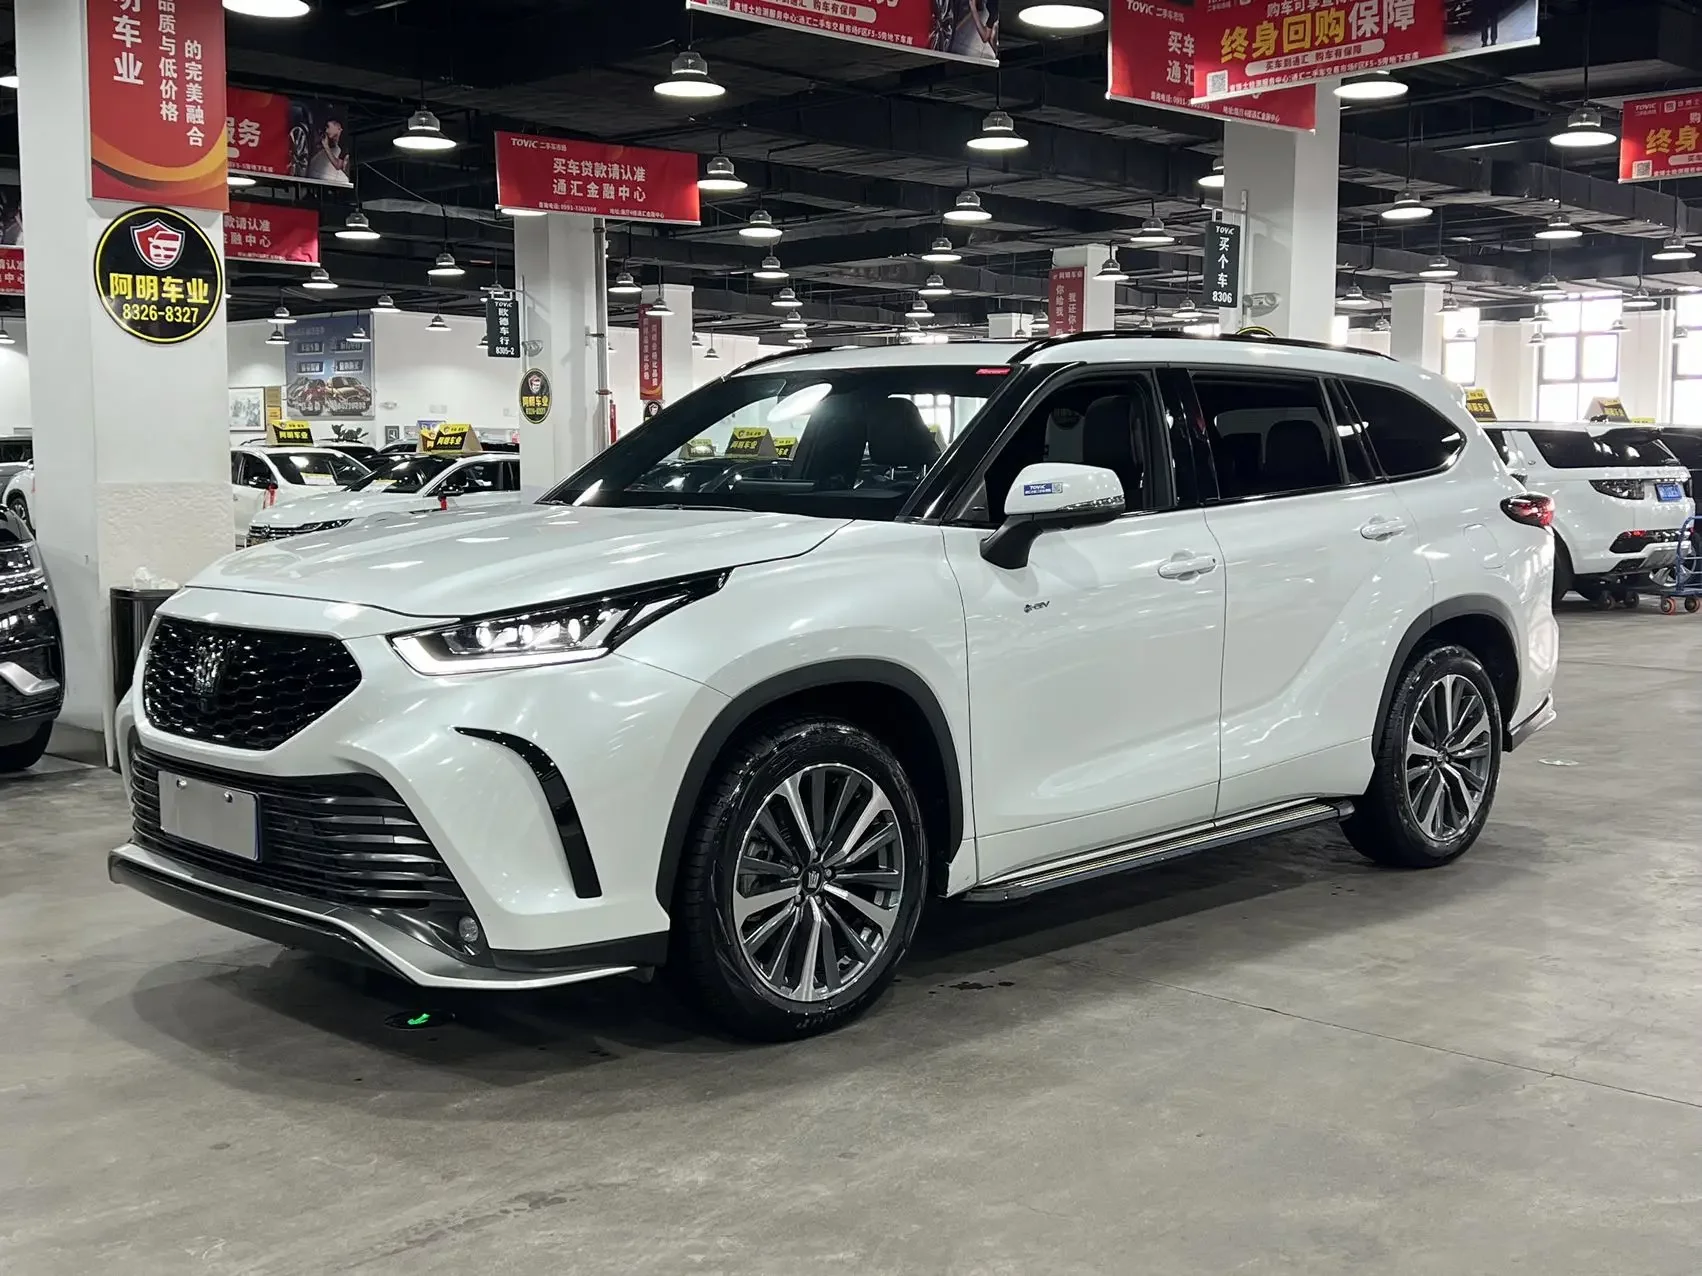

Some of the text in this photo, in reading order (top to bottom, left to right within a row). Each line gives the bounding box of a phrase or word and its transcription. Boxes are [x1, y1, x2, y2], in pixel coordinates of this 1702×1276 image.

[1220, 0, 1416, 64] 终身回购保障
[1315, 44, 1362, 61] 购车有保障
[184, 39, 205, 147] 的完美融合
[511, 138, 538, 149] TOVIC
[553, 157, 646, 182] 买车贷款请认准
[552, 178, 647, 203] 通汇金融中心
[1217, 236, 1230, 288] 买个车
[109, 272, 209, 304] 阿明车业
[1212, 290, 1233, 304] 8306
[122, 303, 199, 323] 8326-8327
